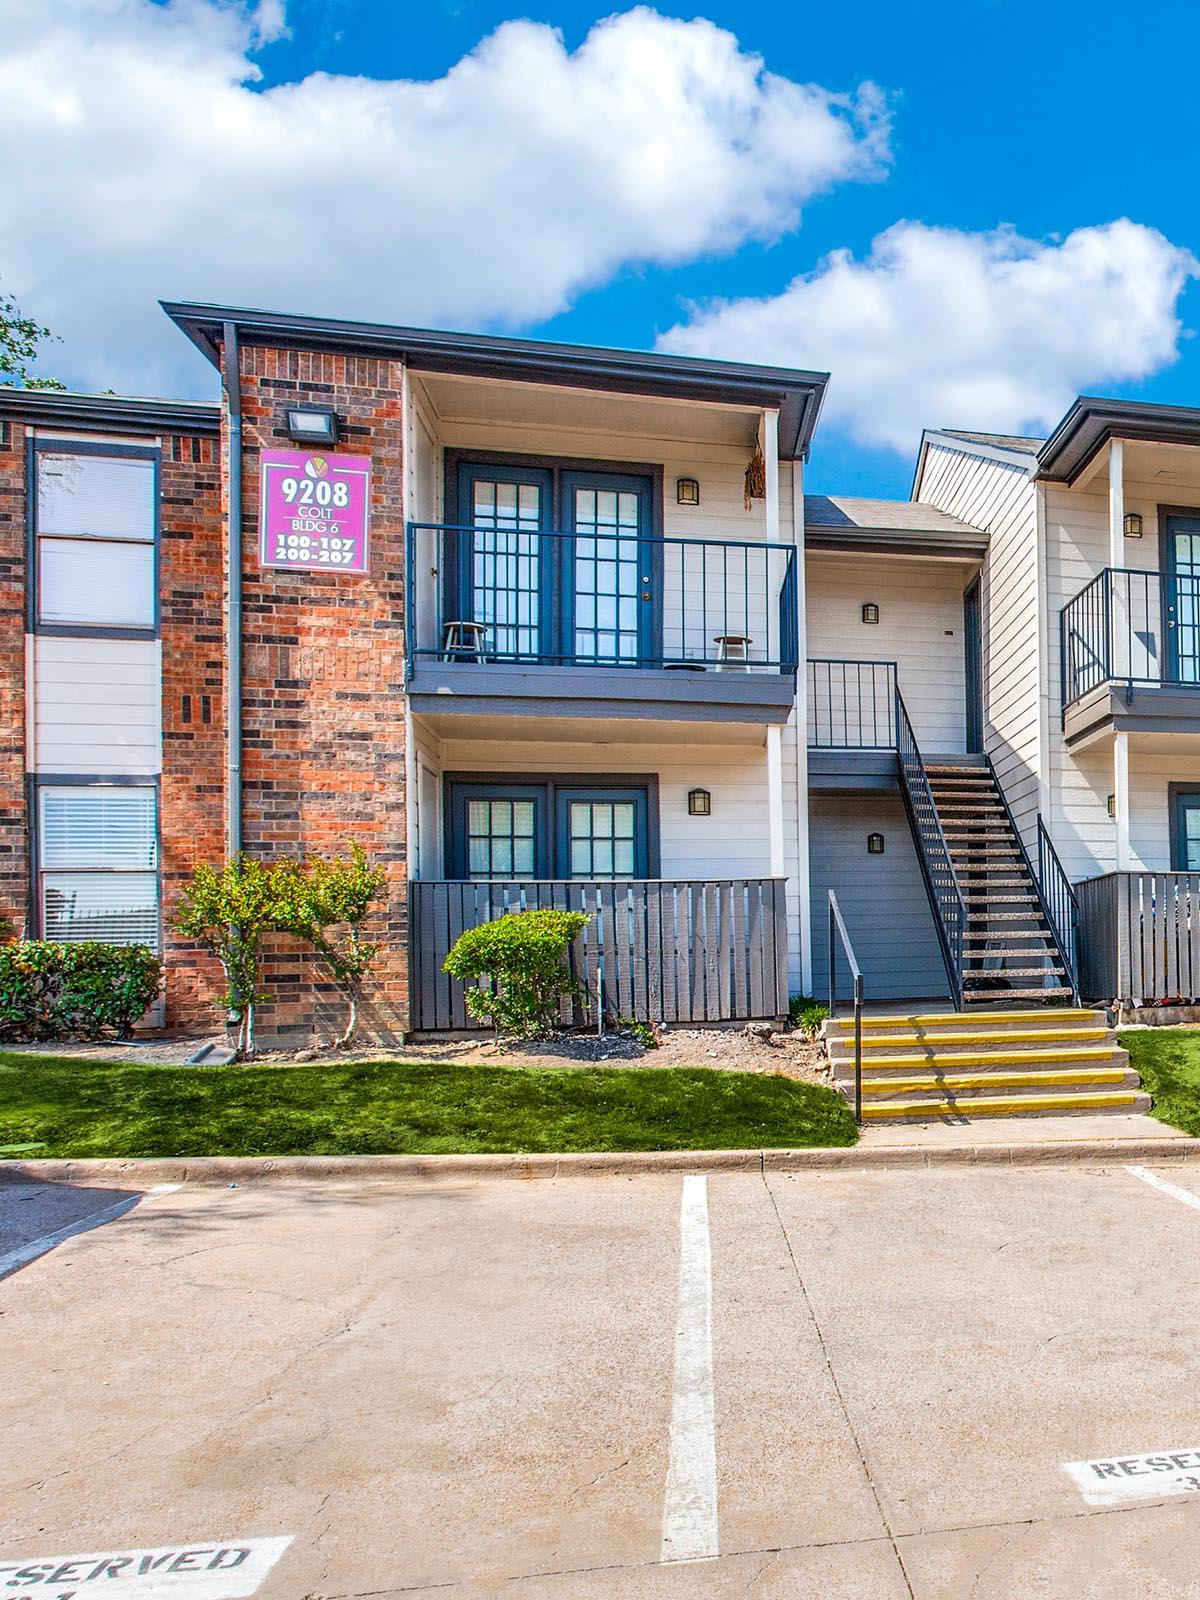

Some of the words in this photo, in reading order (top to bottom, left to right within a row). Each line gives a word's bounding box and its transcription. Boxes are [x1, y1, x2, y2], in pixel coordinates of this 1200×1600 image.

[282, 478, 348, 507] 9208
[298, 506, 334, 519] COLT
[292, 520, 327, 533] BLDG
[330, 523, 339, 534] 6
[277, 534, 354, 551] 100-107
[275, 547, 354, 563] 200-207
